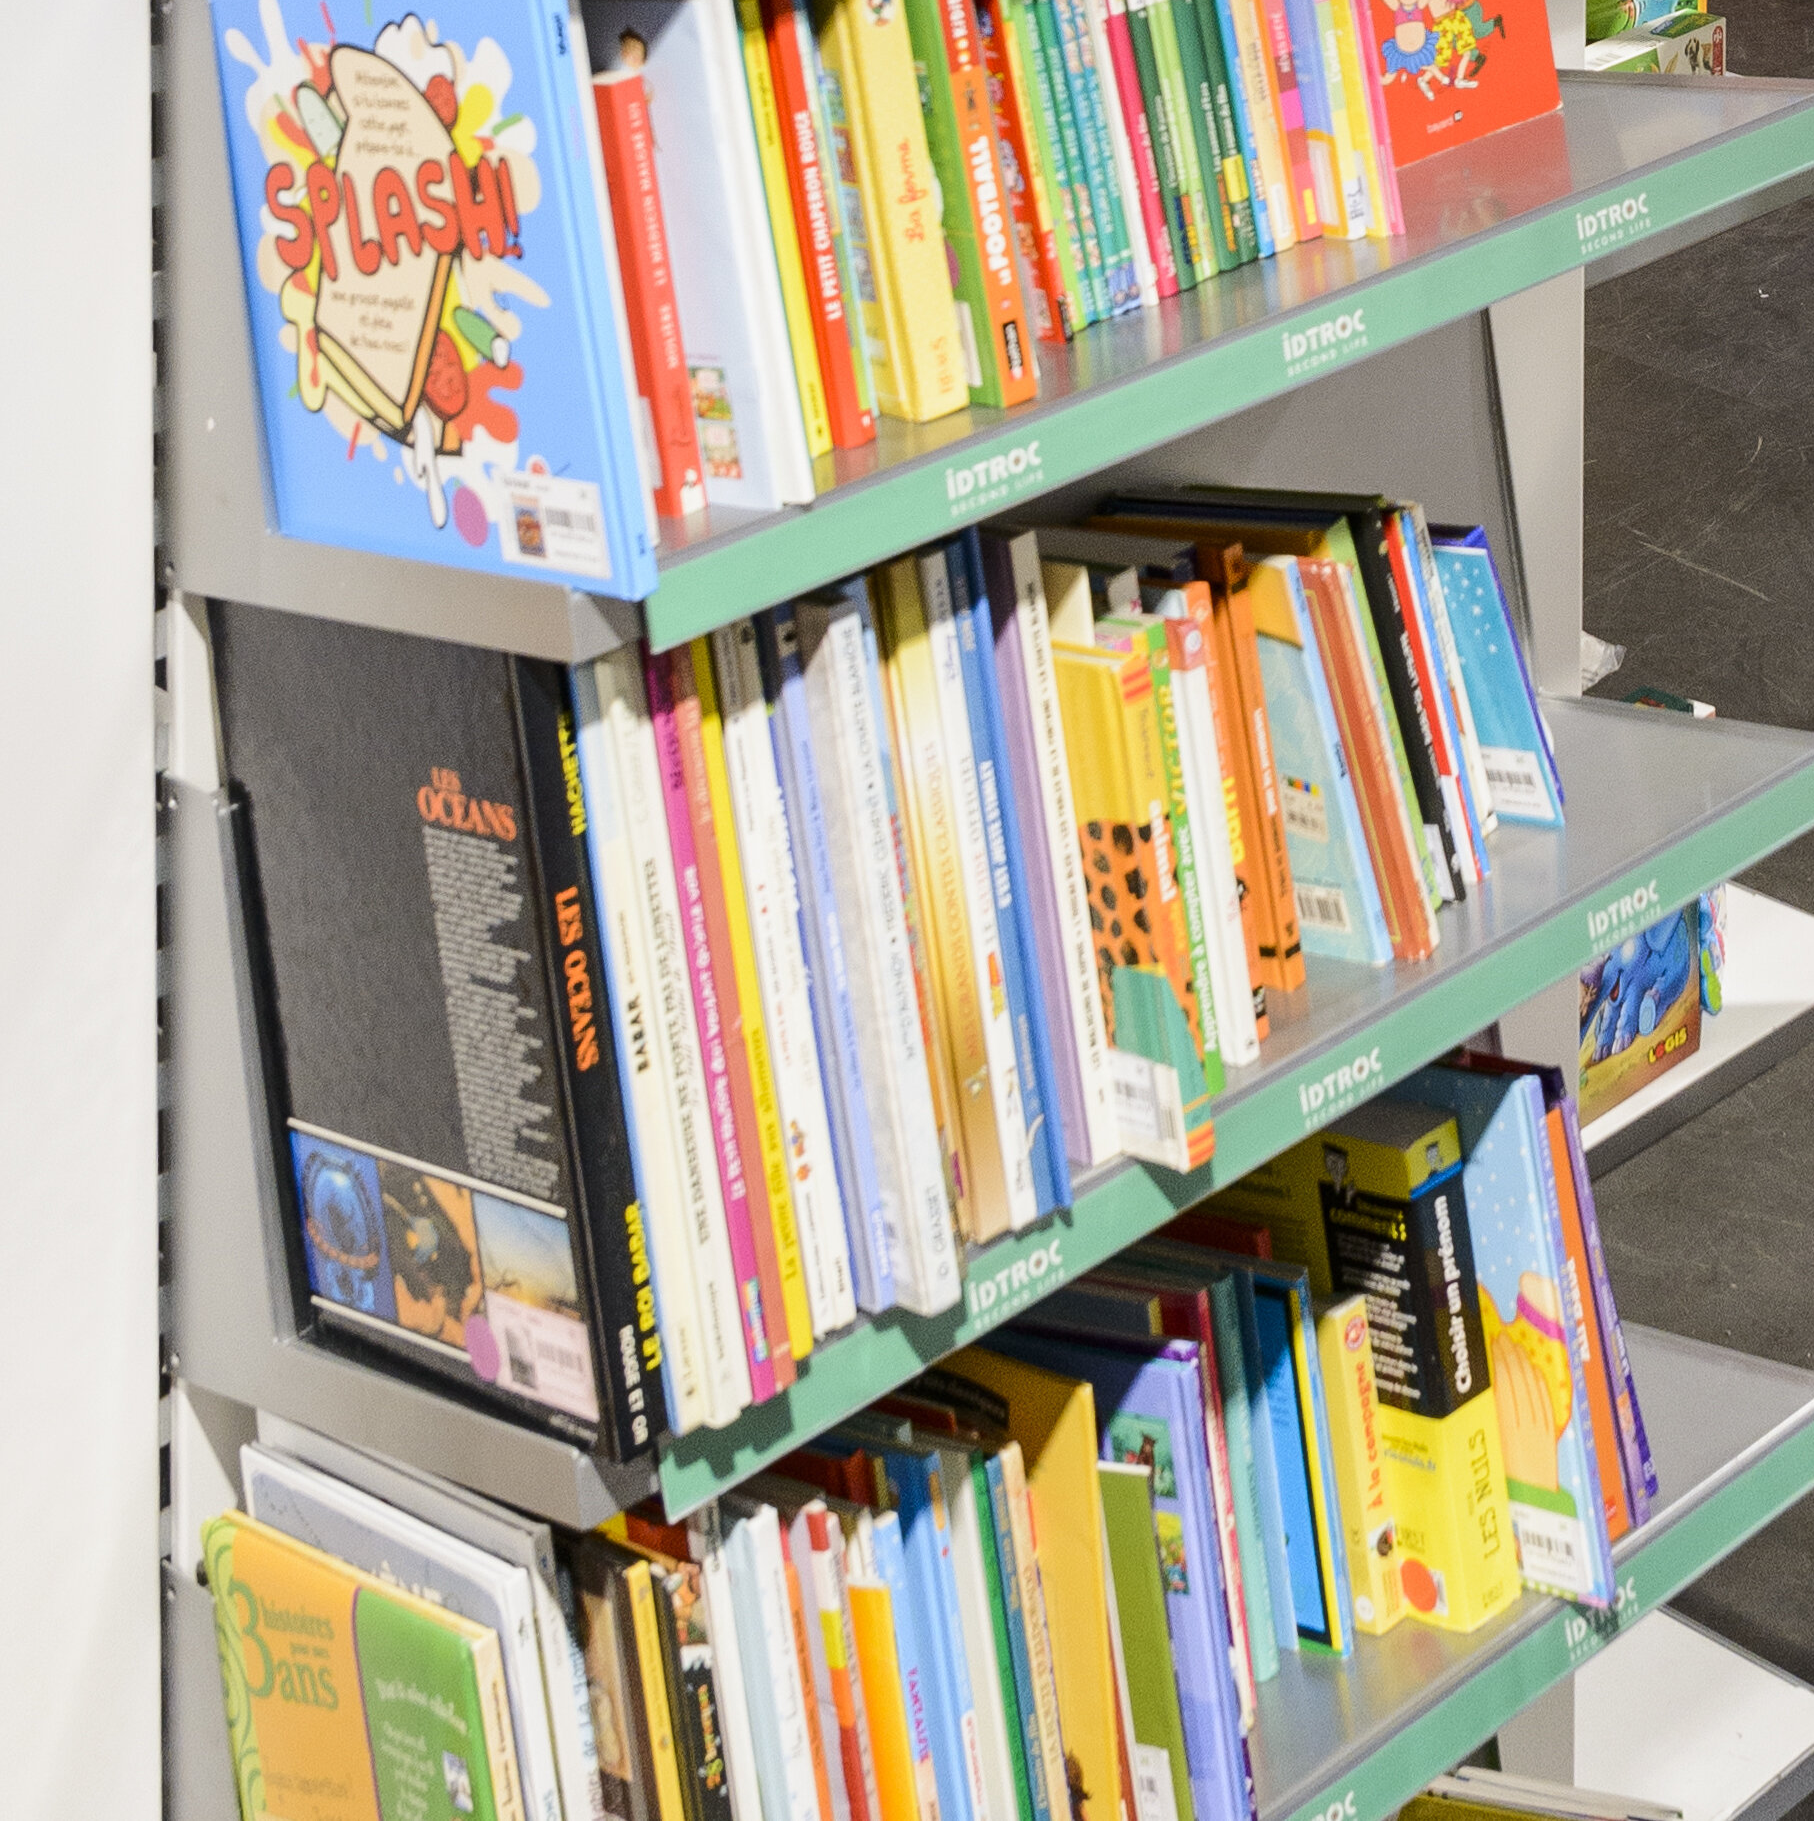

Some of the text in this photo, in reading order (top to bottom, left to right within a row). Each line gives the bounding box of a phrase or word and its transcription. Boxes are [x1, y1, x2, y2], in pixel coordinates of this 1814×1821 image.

[265, 150, 523, 283] SPLASH!
[792, 109, 844, 320] LE PETIT CHAPERON ROUGE
[966, 134, 1010, 271] FOOTBALL
[1174, 823, 1196, 866] avec
[555, 886, 586, 947] LES
[1179, 867, 1209, 943] compter
[1189, 955, 1223, 1053] Apprendre
[635, 1286, 656, 1329] ROI
[1424, 1194, 1477, 1394] Choisir un prénom
[619, 1325, 640, 1384] ROUGE
[642, 1331, 663, 1373] LE
[627, 1385, 643, 1414] ET
[1466, 1427, 1501, 1557] LES NULS
